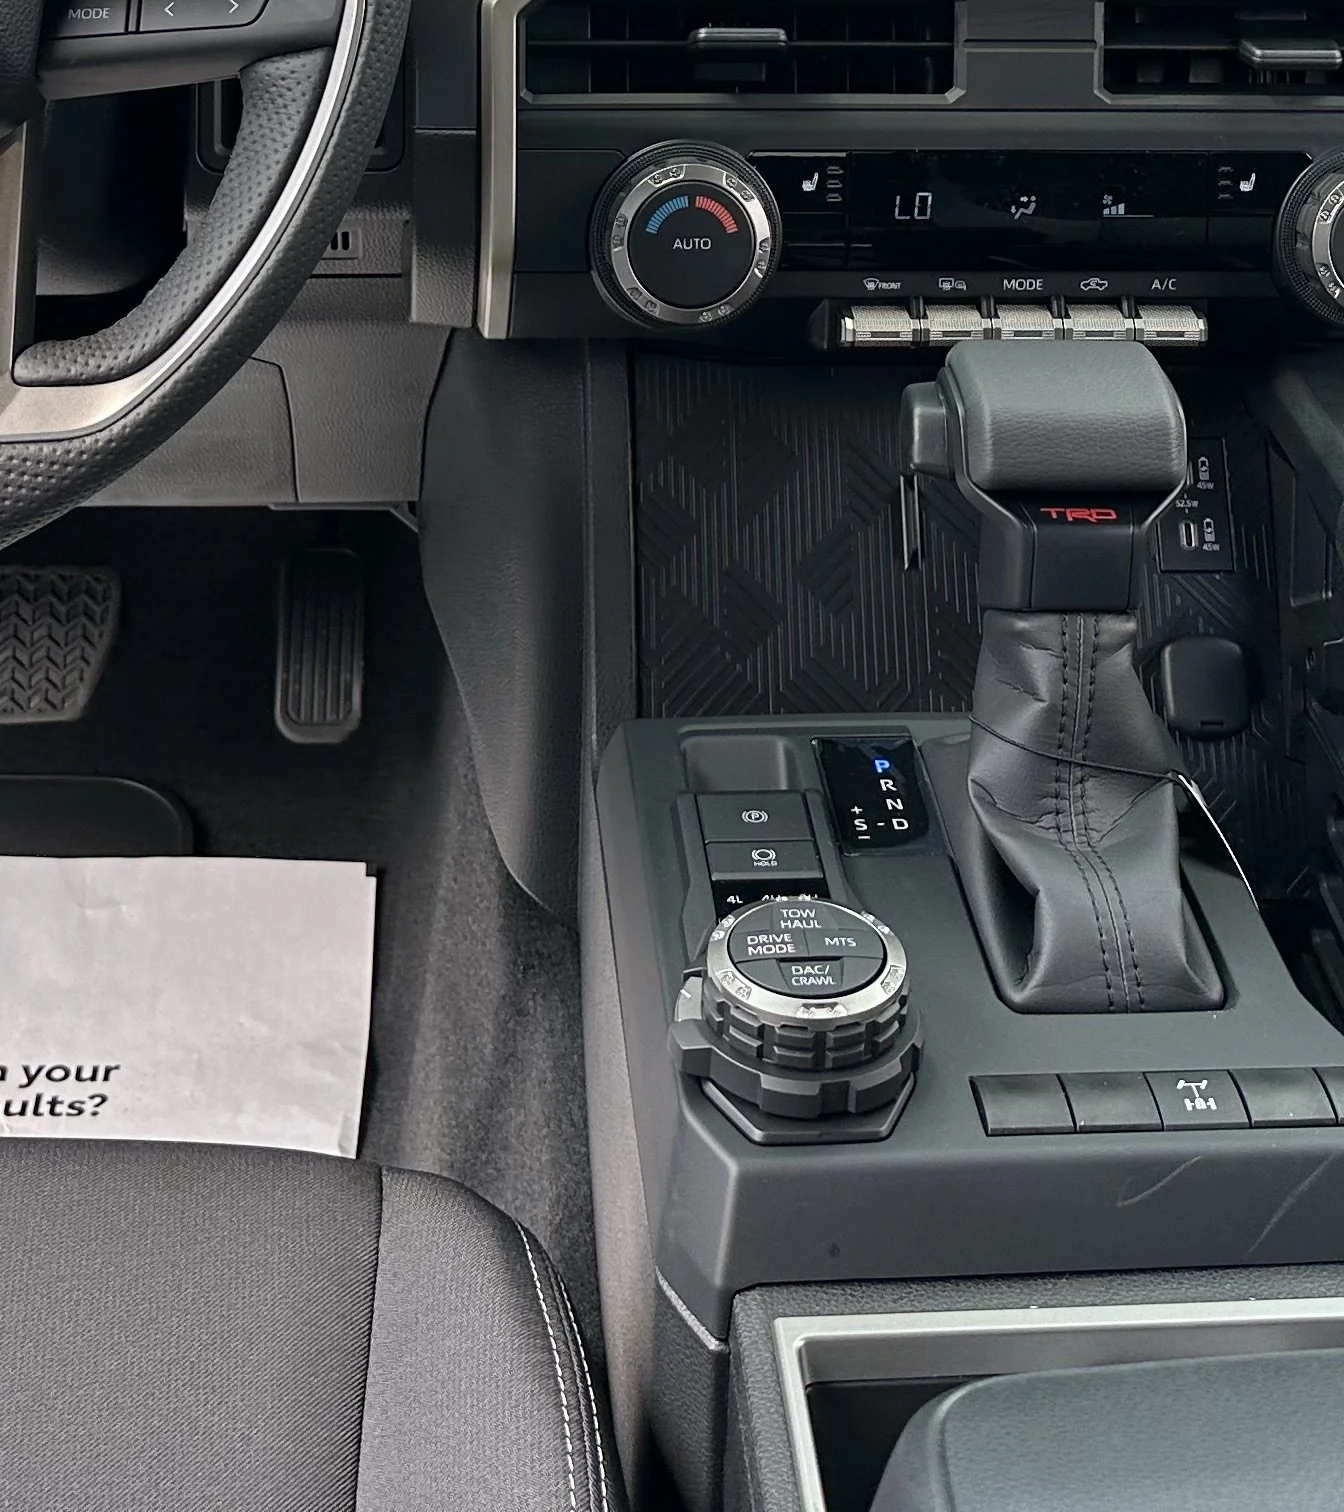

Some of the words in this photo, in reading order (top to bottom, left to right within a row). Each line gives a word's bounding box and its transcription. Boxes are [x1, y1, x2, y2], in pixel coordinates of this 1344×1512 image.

[68, 8, 111, 19] MODE
[672, 238, 712, 250] AUTO
[878, 282, 901, 290] FRONT
[1003, 278, 1044, 291] MODE
[1151, 278, 1177, 291] A/C
[1197, 481, 1215, 490] 45W
[1040, 508, 1117, 522] TRD
[1202, 543, 1220, 551] 45W
[874, 760, 890, 774] P
[880, 779, 898, 792] R
[886, 798, 904, 810] N
[854, 819, 868, 831] S
[891, 819, 909, 830] D
[727, 895, 743, 904] 4L
[780, 908, 816, 918] TOW
[781, 919, 822, 929] HAUL
[747, 933, 793, 945] DRIVE
[825, 937, 857, 947] MTS
[748, 944, 796, 956] MODE
[791, 965, 831, 975] DAC/
[791, 976, 836, 986] CRAWL
[18, 1062, 120, 1089] your
